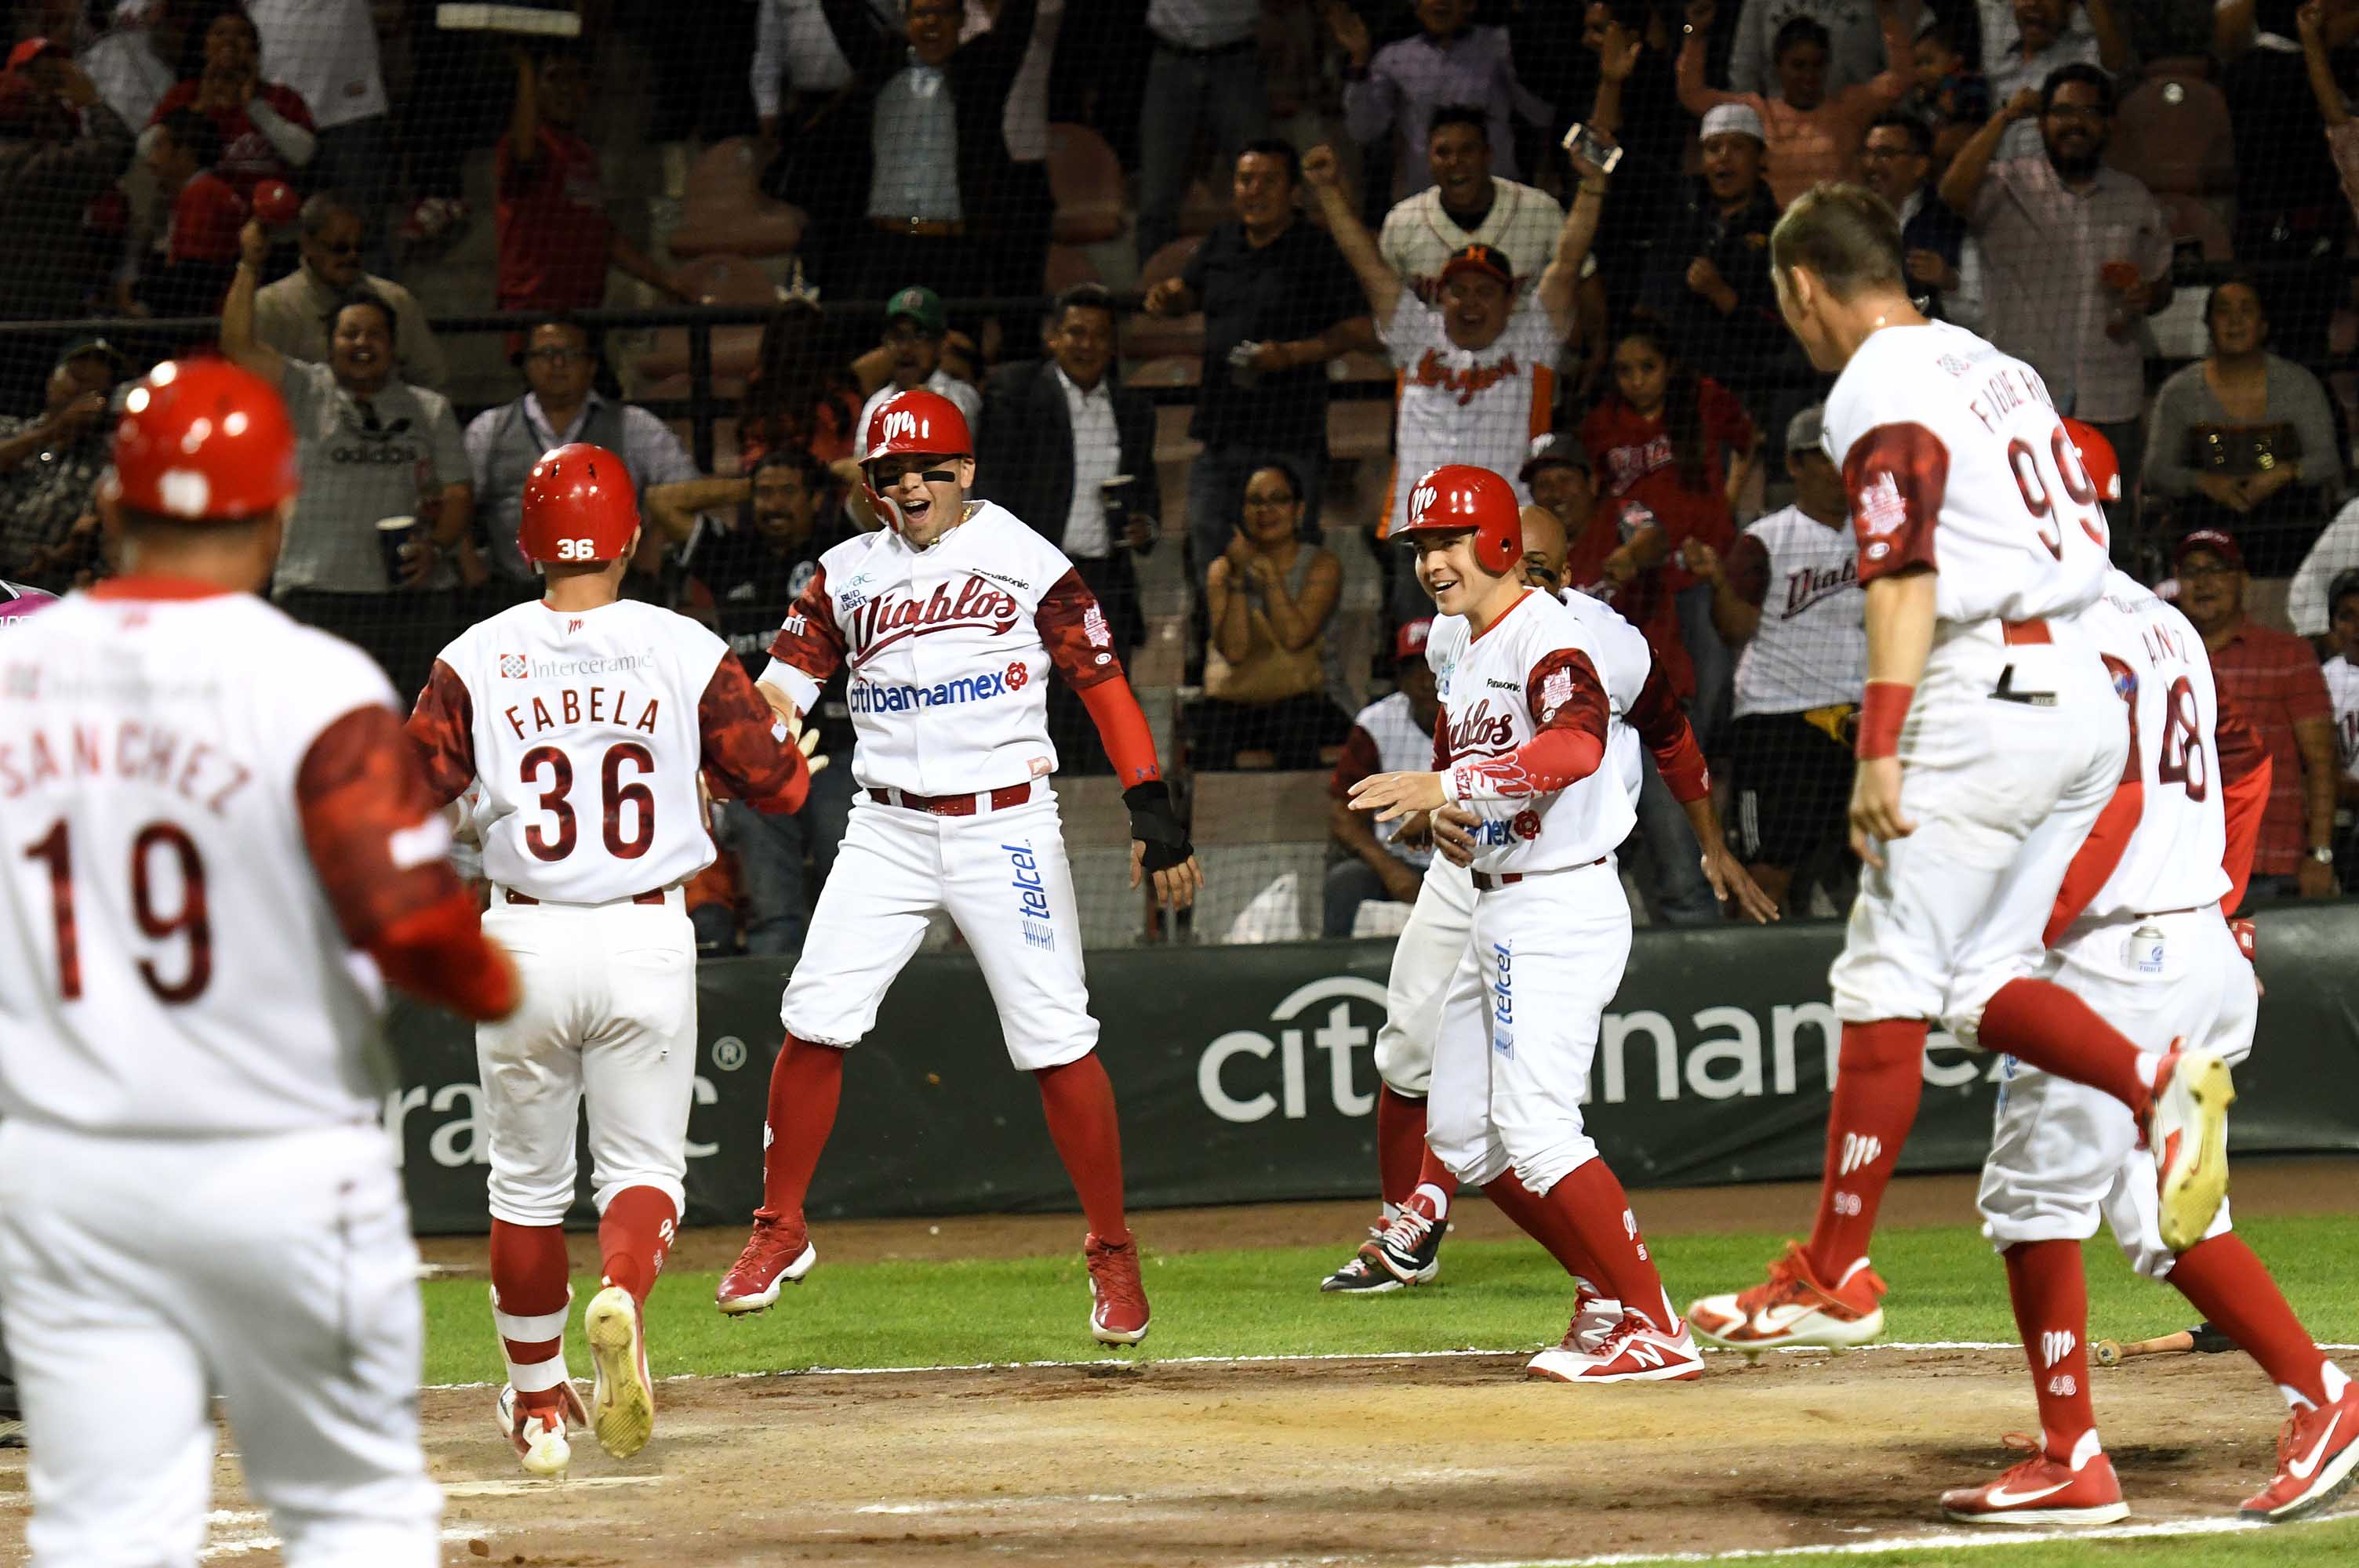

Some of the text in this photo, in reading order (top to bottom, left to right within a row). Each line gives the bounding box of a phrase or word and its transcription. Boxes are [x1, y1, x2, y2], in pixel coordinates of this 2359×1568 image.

[332, 444, 415, 463] adidas
[2008, 423, 2110, 562] 99
[557, 539, 594, 559] 36
[840, 589, 860, 602] BUD
[841, 595, 867, 612] LIGHT
[853, 575, 1017, 657] Diablos
[504, 687, 660, 740] FABELA
[2159, 675, 2207, 804] 48
[0, 721, 253, 818] SANCHEZ
[520, 742, 656, 862] 36
[24, 813, 216, 1008] 19
[1001, 844, 1051, 920] telcel
[1493, 942, 1513, 1025] telcel
[1835, 1191, 1862, 1217] 99
[1636, 1243, 1648, 1261] 5
[2050, 1374, 2077, 1396] 48
